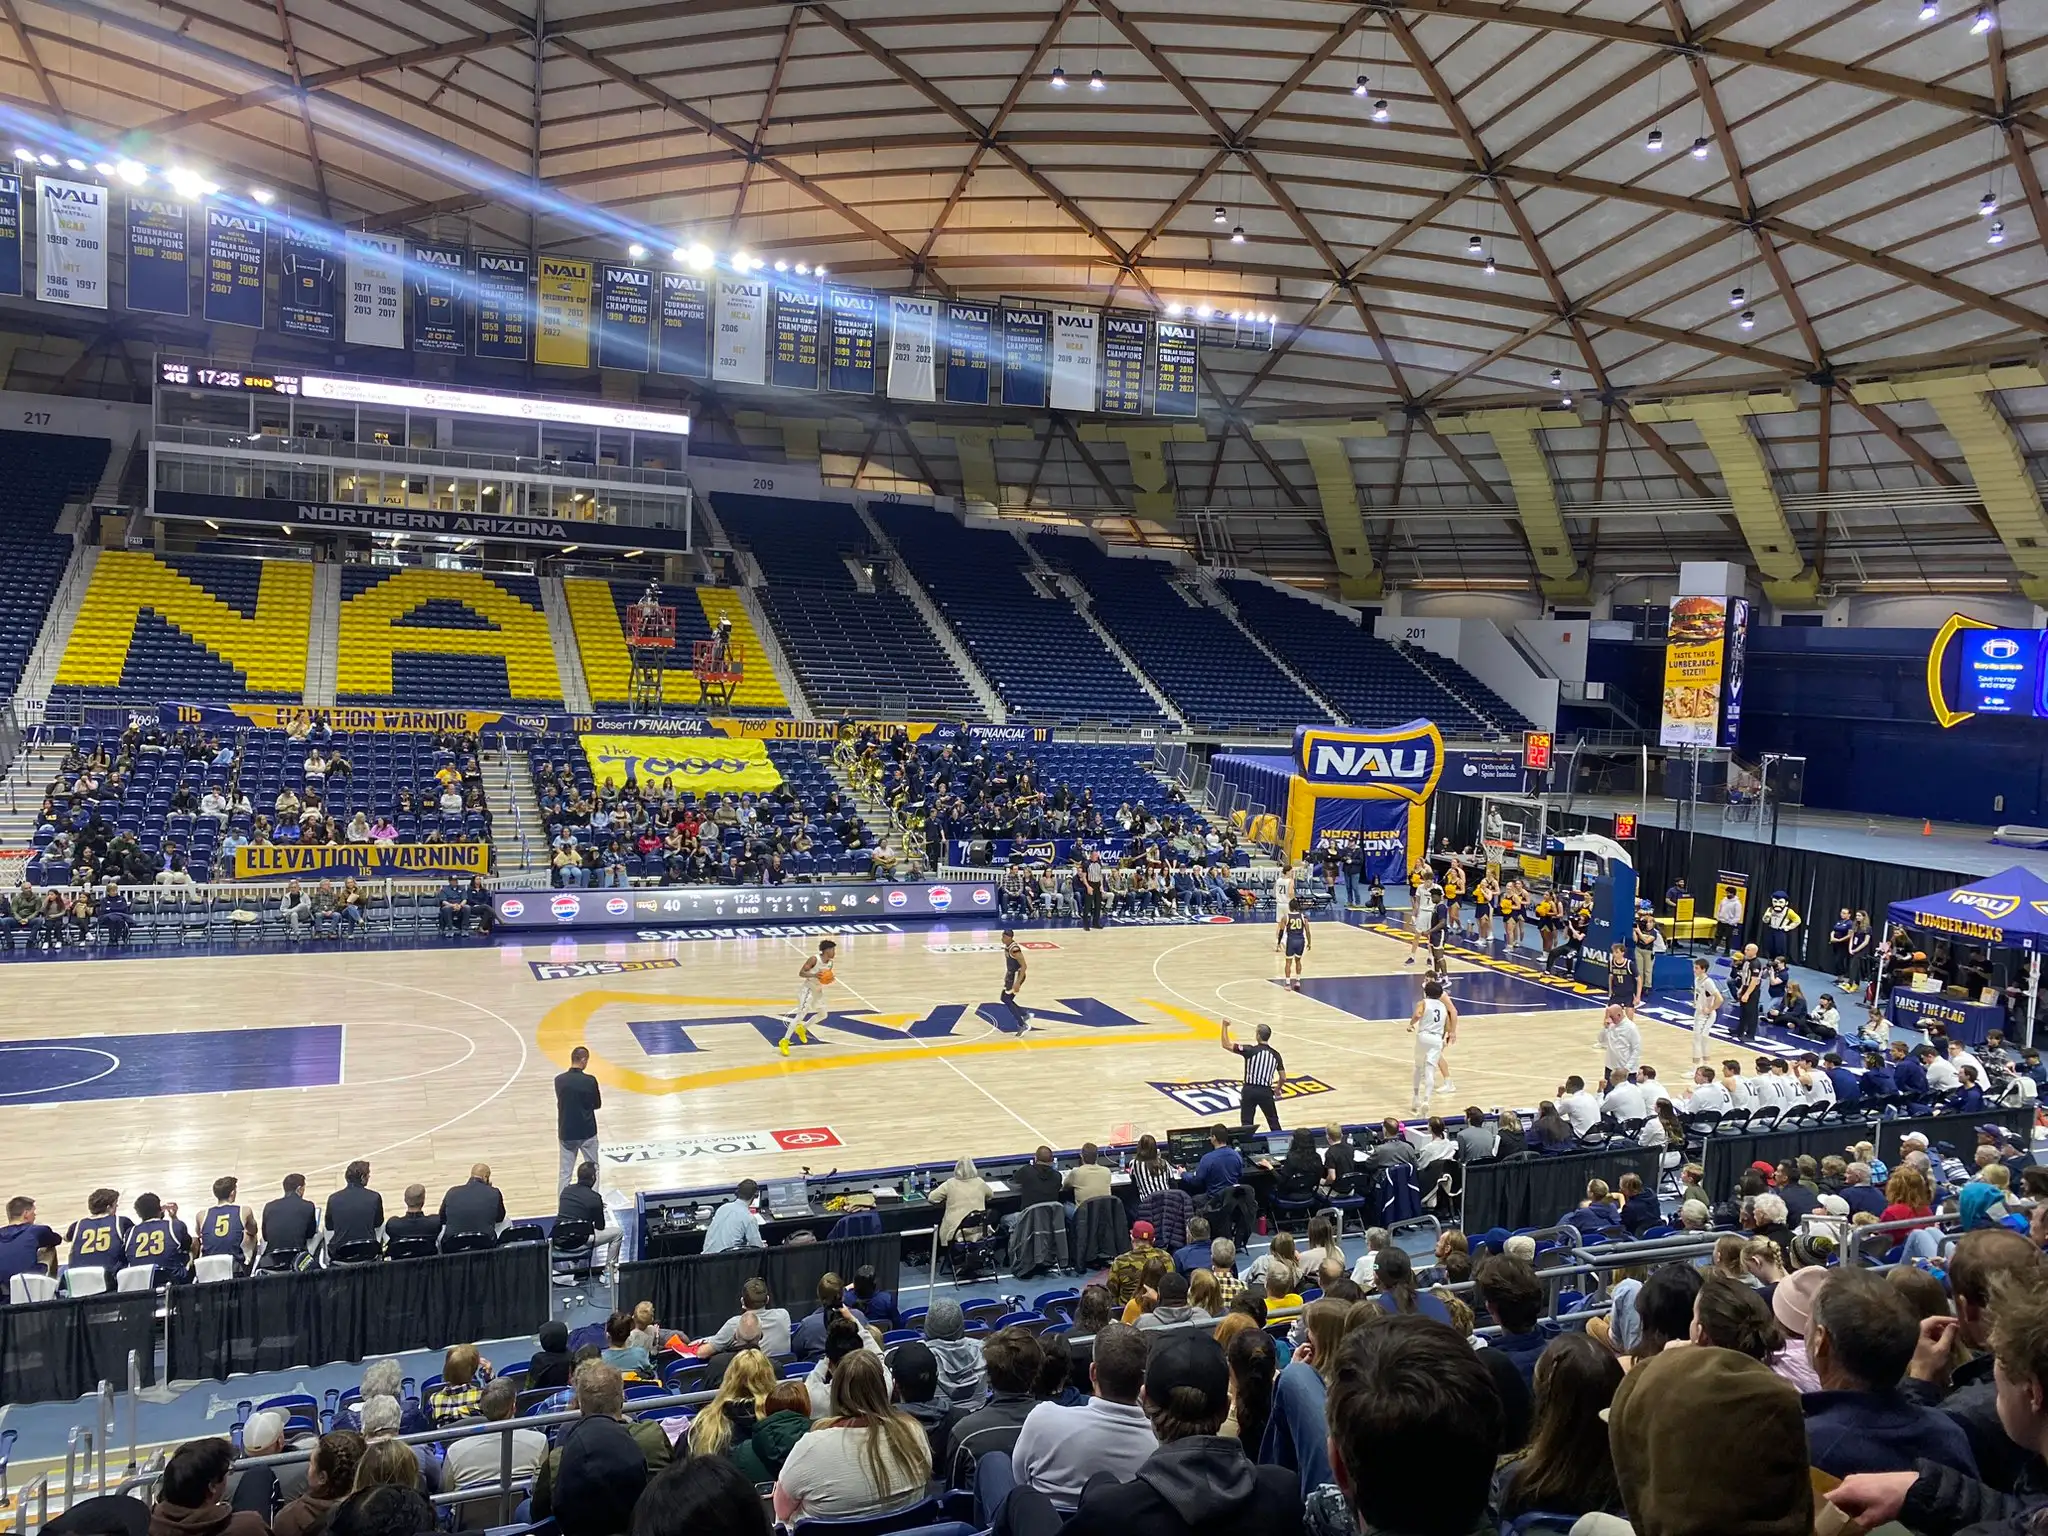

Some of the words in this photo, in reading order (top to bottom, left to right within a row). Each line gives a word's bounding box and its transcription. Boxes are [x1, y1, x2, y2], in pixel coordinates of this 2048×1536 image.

[45, 186, 98, 205] NAU
[131, 198, 183, 218] NAU
[211, 212, 263, 233] NAU
[131, 226, 184, 240] TOURNAMENT
[47, 234, 69, 246] 1998
[75, 239, 98, 250] 2000
[131, 234, 184, 250] CHAMPIONS
[210, 248, 260, 264] CHAMPIONS
[416, 249, 461, 266] NAU
[480, 257, 525, 272] NAU
[543, 264, 586, 280] NAU
[607, 270, 649, 286] NAU
[46, 275, 68, 287] 1986
[76, 280, 97, 290] 1997
[302, 278, 314, 288] 9
[664, 277, 705, 292] NAU
[46, 288, 70, 299] 2006
[722, 283, 761, 297] NAU
[378, 297, 397, 307] 2003
[778, 291, 818, 307] NAU
[835, 295, 874, 311] NAU
[353, 305, 372, 315] 2013
[379, 308, 396, 319] 2017
[606, 303, 648, 314] CHAMPIONS
[664, 309, 705, 321] CHAMPIONS
[896, 301, 933, 317] NAU
[951, 308, 988, 323] NAU
[1007, 312, 1044, 326] NAU
[1057, 315, 1093, 329] NAU
[777, 322, 818, 334] CHAMPIONS
[834, 327, 873, 338] CHAMPIONS
[1108, 321, 1144, 334] NAU
[1160, 326, 1196, 340] NAU
[1007, 342, 1043, 353] CHAMPIONS
[916, 355, 932, 365] 2022
[1107, 350, 1143, 360] CHAMPIONS
[1159, 355, 1195, 365] CHAMPIONS
[163, 364, 189, 373] NAU
[163, 371, 189, 384] 40
[197, 369, 240, 387] 17:25
[244, 377, 273, 388] 2ND
[1159, 383, 1174, 393] 2022
[23, 411, 51, 426] 217
[753, 478, 774, 491] 209
[883, 494, 902, 503] 207
[297, 505, 446, 530] NORTHERN
[452, 517, 567, 540] ARIZONA
[1040, 523, 1059, 536] 205
[1218, 569, 1236, 580] 203
[1405, 627, 1426, 640] 201
[1674, 652, 1692, 660] TASTE
[1708, 650, 1716, 658] IS
[1668, 658, 1720, 670] LUMBERJACK-
[1682, 667, 1707, 677] SIZE!!!
[1993, 683, 2016, 691] energy
[1994, 677, 2017, 685] money
[26, 700, 44, 710] 115
[177, 706, 202, 723] 115
[382, 710, 468, 730] WARNING
[518, 717, 545, 729] NAU
[572, 717, 592, 733] 113
[596, 718, 633, 731] desert
[738, 720, 767, 738] 7000
[1033, 728, 1047, 742] 111
[1529, 735, 1550, 748] 17:25
[602, 744, 632, 756] The
[1528, 745, 1547, 766] 22
[1315, 745, 1428, 778] NAU
[1481, 763, 1509, 773] Orthopedic
[596, 756, 749, 783] 7000
[1481, 770, 1495, 780] Spine
[1496, 771, 1517, 779] Institute
[1619, 816, 1633, 826] 17:25
[1320, 829, 1400, 840] NORTHERN
[1619, 825, 1632, 837] 22
[1316, 838, 1405, 851] ARIONA
[246, 847, 369, 869] ELEVATION
[376, 845, 480, 868] WARNING
[358, 866, 372, 877] 115
[1278, 885, 1287, 895] 21
[663, 899, 681, 912] 40
[733, 893, 761, 904] 17:25
[841, 894, 858, 908] 48
[1953, 894, 2010, 912] NAU
[1289, 918, 1302, 930] 20
[1599, 919, 1610, 930] aps
[1914, 911, 2004, 945] LUMBERJACKS
[636, 923, 906, 942] LUMBERJACKS
[1582, 946, 1613, 964] NAU
[539, 963, 621, 982] SKY
[1617, 975, 1624, 984] 11
[1433, 1008, 1441, 1023] 3
[1895, 995, 1921, 1013] RAISE
[1922, 1002, 1940, 1018] THE
[1940, 1007, 1966, 1025] FLAG
[626, 997, 1150, 1057] NAU
[1774, 1082, 1785, 1098] 11
[1819, 1079, 1833, 1094] 13
[213, 1213, 230, 1238] 5
[80, 1226, 111, 1256] 25
[135, 1229, 165, 1258] 23
